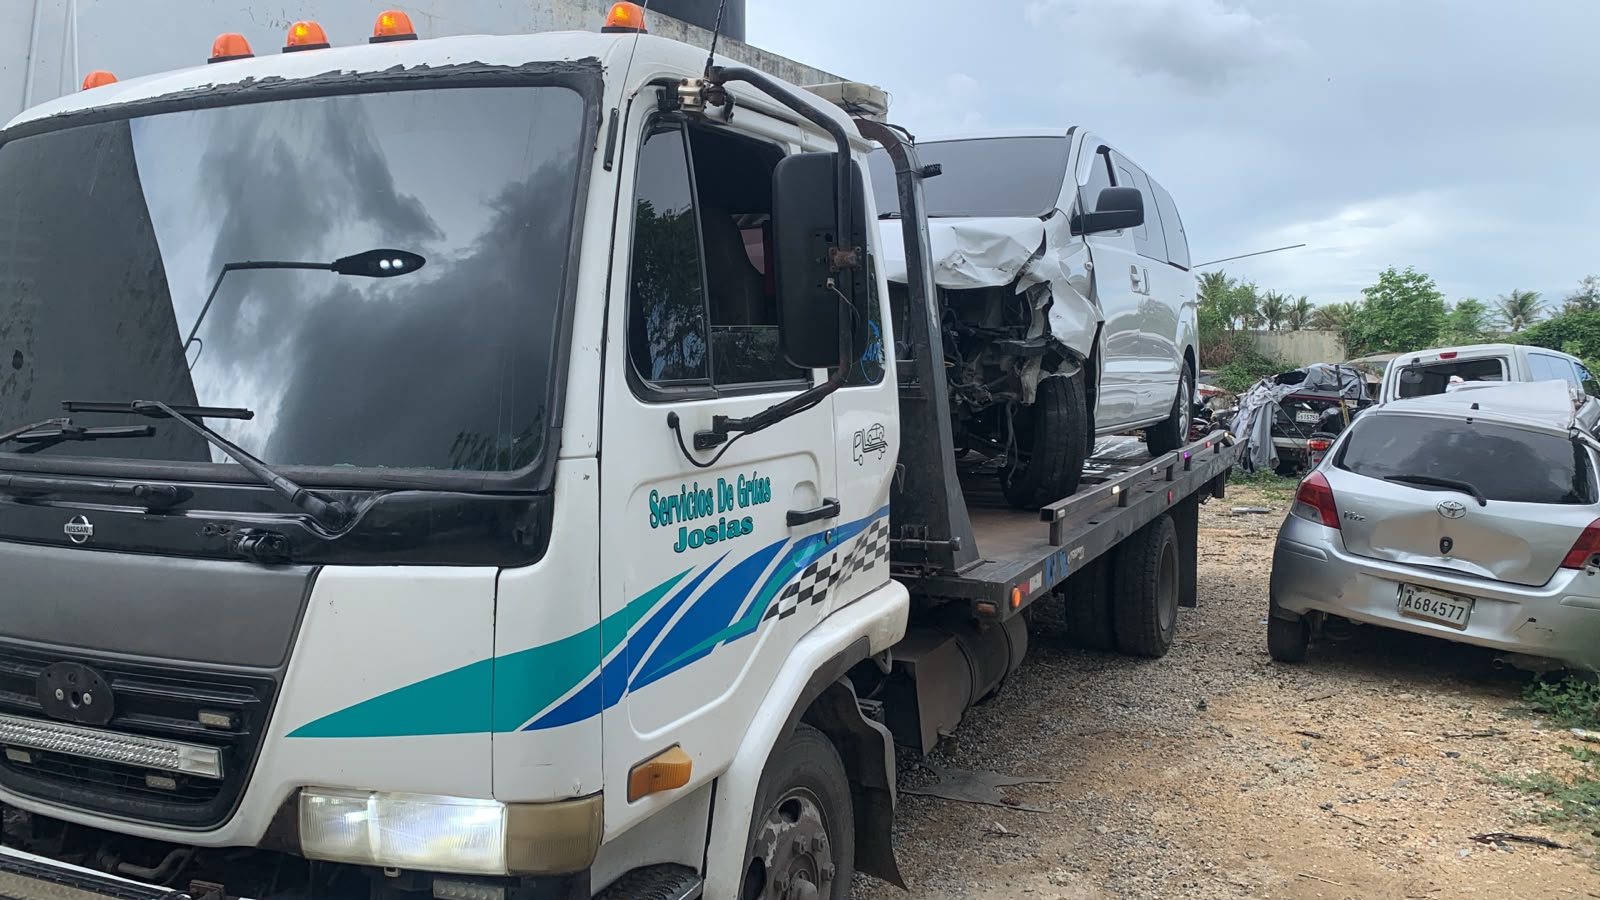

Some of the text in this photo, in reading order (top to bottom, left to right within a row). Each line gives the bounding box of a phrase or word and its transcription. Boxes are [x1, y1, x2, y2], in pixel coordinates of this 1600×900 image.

[649, 471, 771, 529] Servicios De Grúas
[66, 525, 89, 534] NISSAN
[673, 516, 754, 553] Josias
[1404, 594, 1465, 620] A684577
